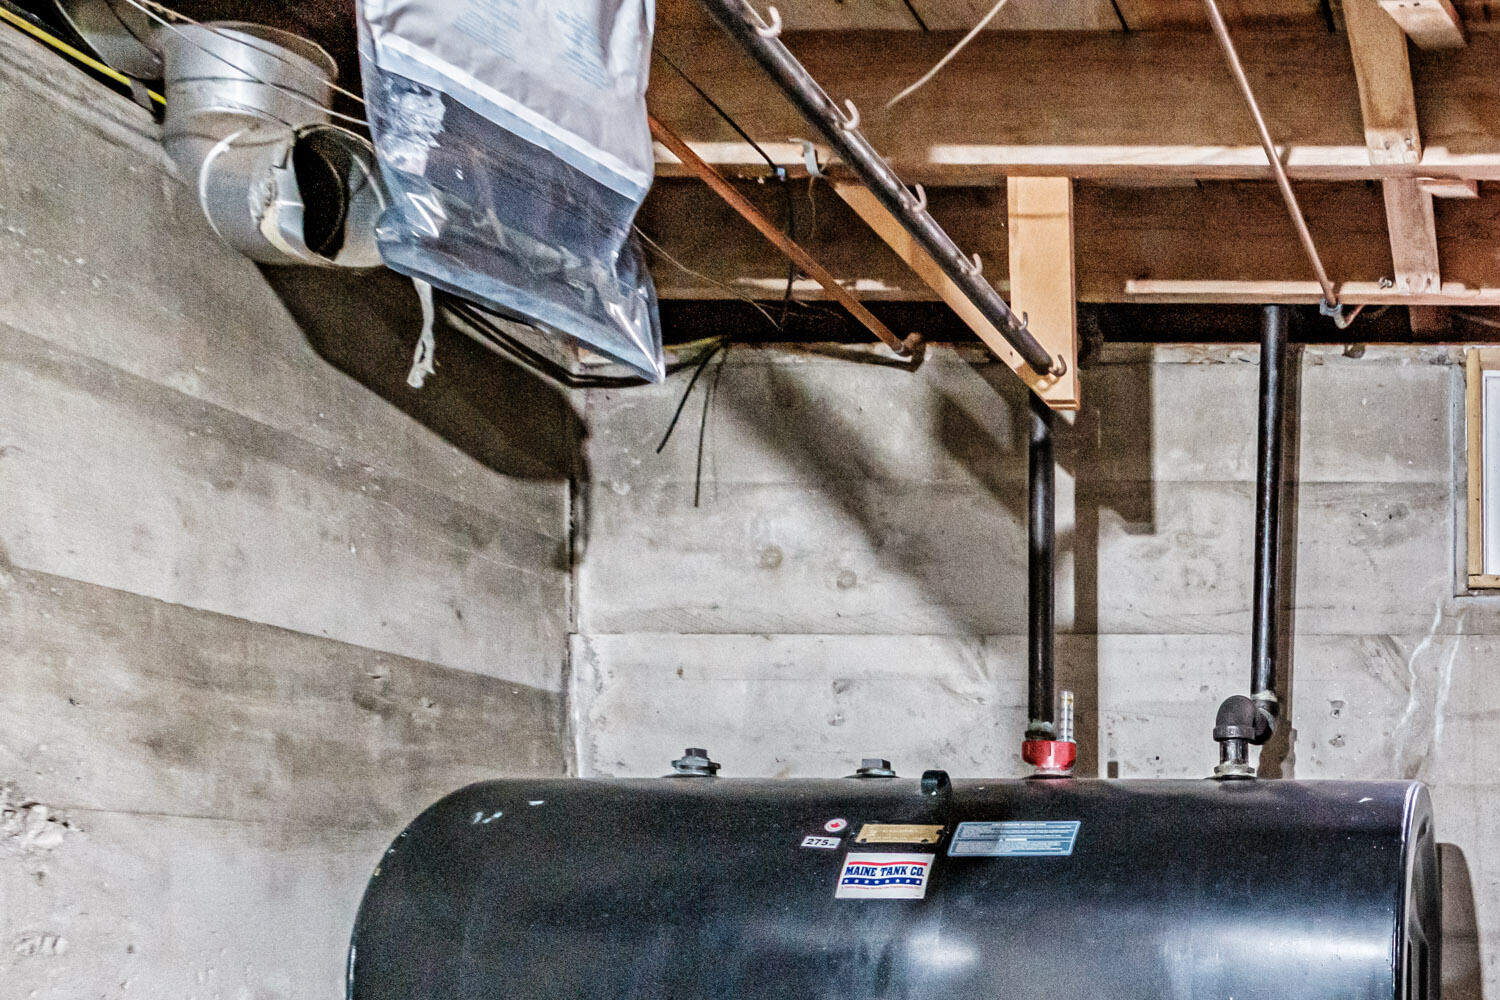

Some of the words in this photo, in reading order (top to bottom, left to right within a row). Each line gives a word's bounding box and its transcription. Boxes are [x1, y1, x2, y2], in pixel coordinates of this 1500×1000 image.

[805, 838, 829, 846] 275
[844, 866, 878, 877] MAINE
[880, 866, 908, 877] TANK
[910, 866, 925, 877] CO.
